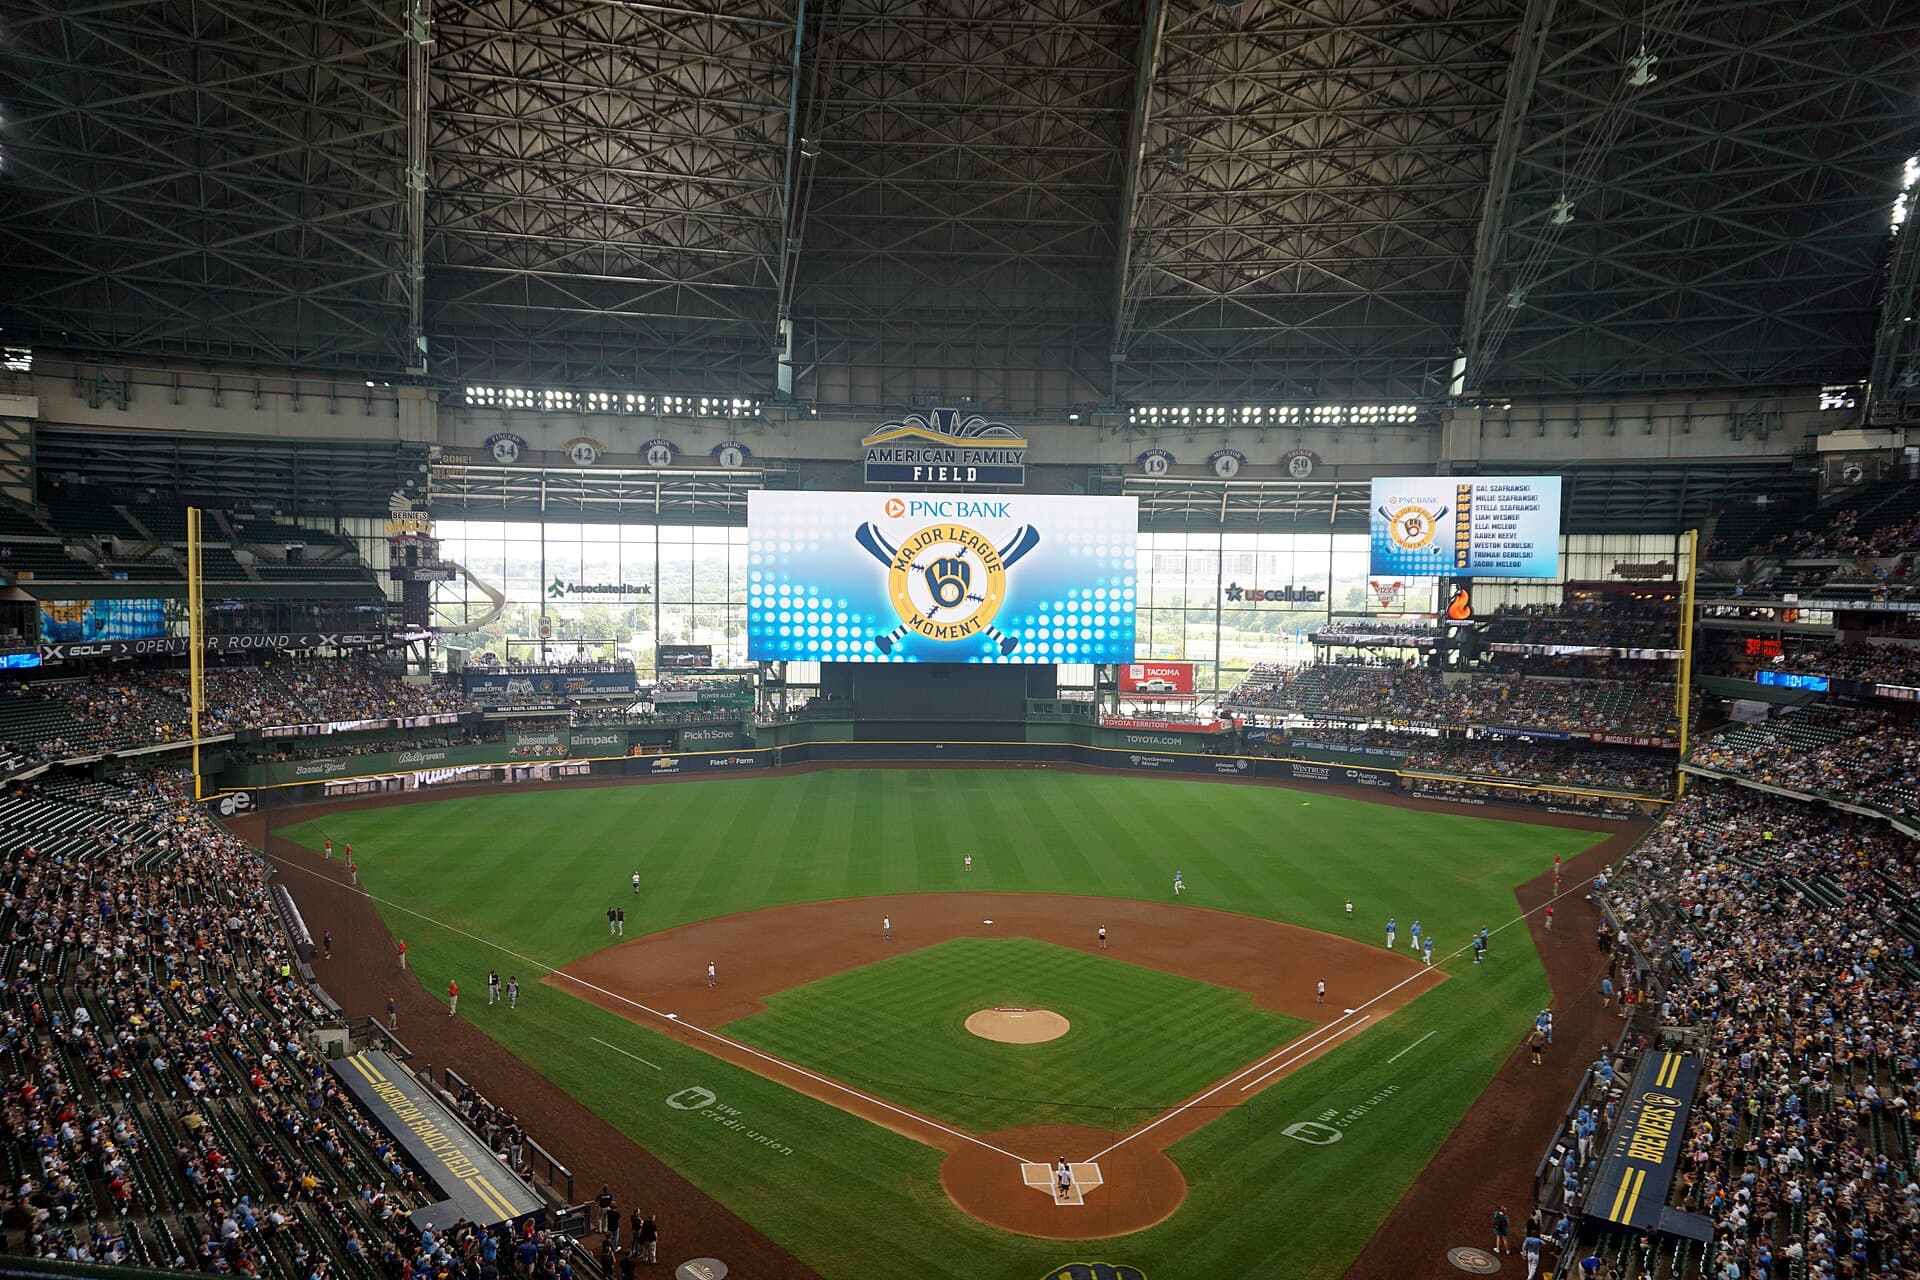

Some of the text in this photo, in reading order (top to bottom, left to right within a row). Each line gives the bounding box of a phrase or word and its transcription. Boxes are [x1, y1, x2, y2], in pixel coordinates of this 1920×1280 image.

[496, 445, 514, 458] 34
[574, 448, 593, 460] 42
[650, 450, 668, 463] 44
[866, 449, 1023, 464] AMERICAN FAMILY
[728, 453, 736, 466] 1
[1294, 458, 1308, 468] 50
[1148, 460, 1164, 472] 19
[1221, 461, 1231, 472] 4
[914, 466, 977, 482] FIELD
[1398, 496, 1416, 504] PNC
[910, 500, 1011, 518] PNC BANK
[385, 519, 434, 534] CHALET
[894, 528, 1001, 574] MAJOR LEAGUE
[566, 583, 652, 595] Associated Bank
[1244, 585, 1325, 602] uscellular
[909, 614, 981, 638] MOMENT
[42, 646, 65, 660] X
[69, 644, 112, 656] GOLF
[136, 640, 174, 654] OPEN
[179, 635, 219, 650] YR
[228, 635, 290, 648] ROUND
[318, 634, 338, 646] X
[342, 634, 382, 644] GOLF
[1147, 668, 1180, 676] TACOMA
[1106, 719, 1168, 730] TOYOTA TERRITORY
[1410, 720, 1437, 728] WTMJ
[516, 734, 559, 746] Johnsonville
[580, 734, 618, 746] impact
[712, 730, 734, 739] Save
[1127, 735, 1182, 746] TOYOTA.COM
[1605, 736, 1650, 746] NICOLET LAW
[399, 752, 446, 764] Bally SPORTS
[1358, 772, 1378, 780] Aurora
[1358, 778, 1377, 786] Health
[716, 1104, 742, 1116] uw
[1336, 1084, 1400, 1127] credit union
[1317, 1108, 1339, 1122] uw
[371, 1081, 480, 1179] AMERICAN FAMILY FIELD
[701, 1109, 793, 1156] credit union
[1627, 1105, 1676, 1164] BREWERS
